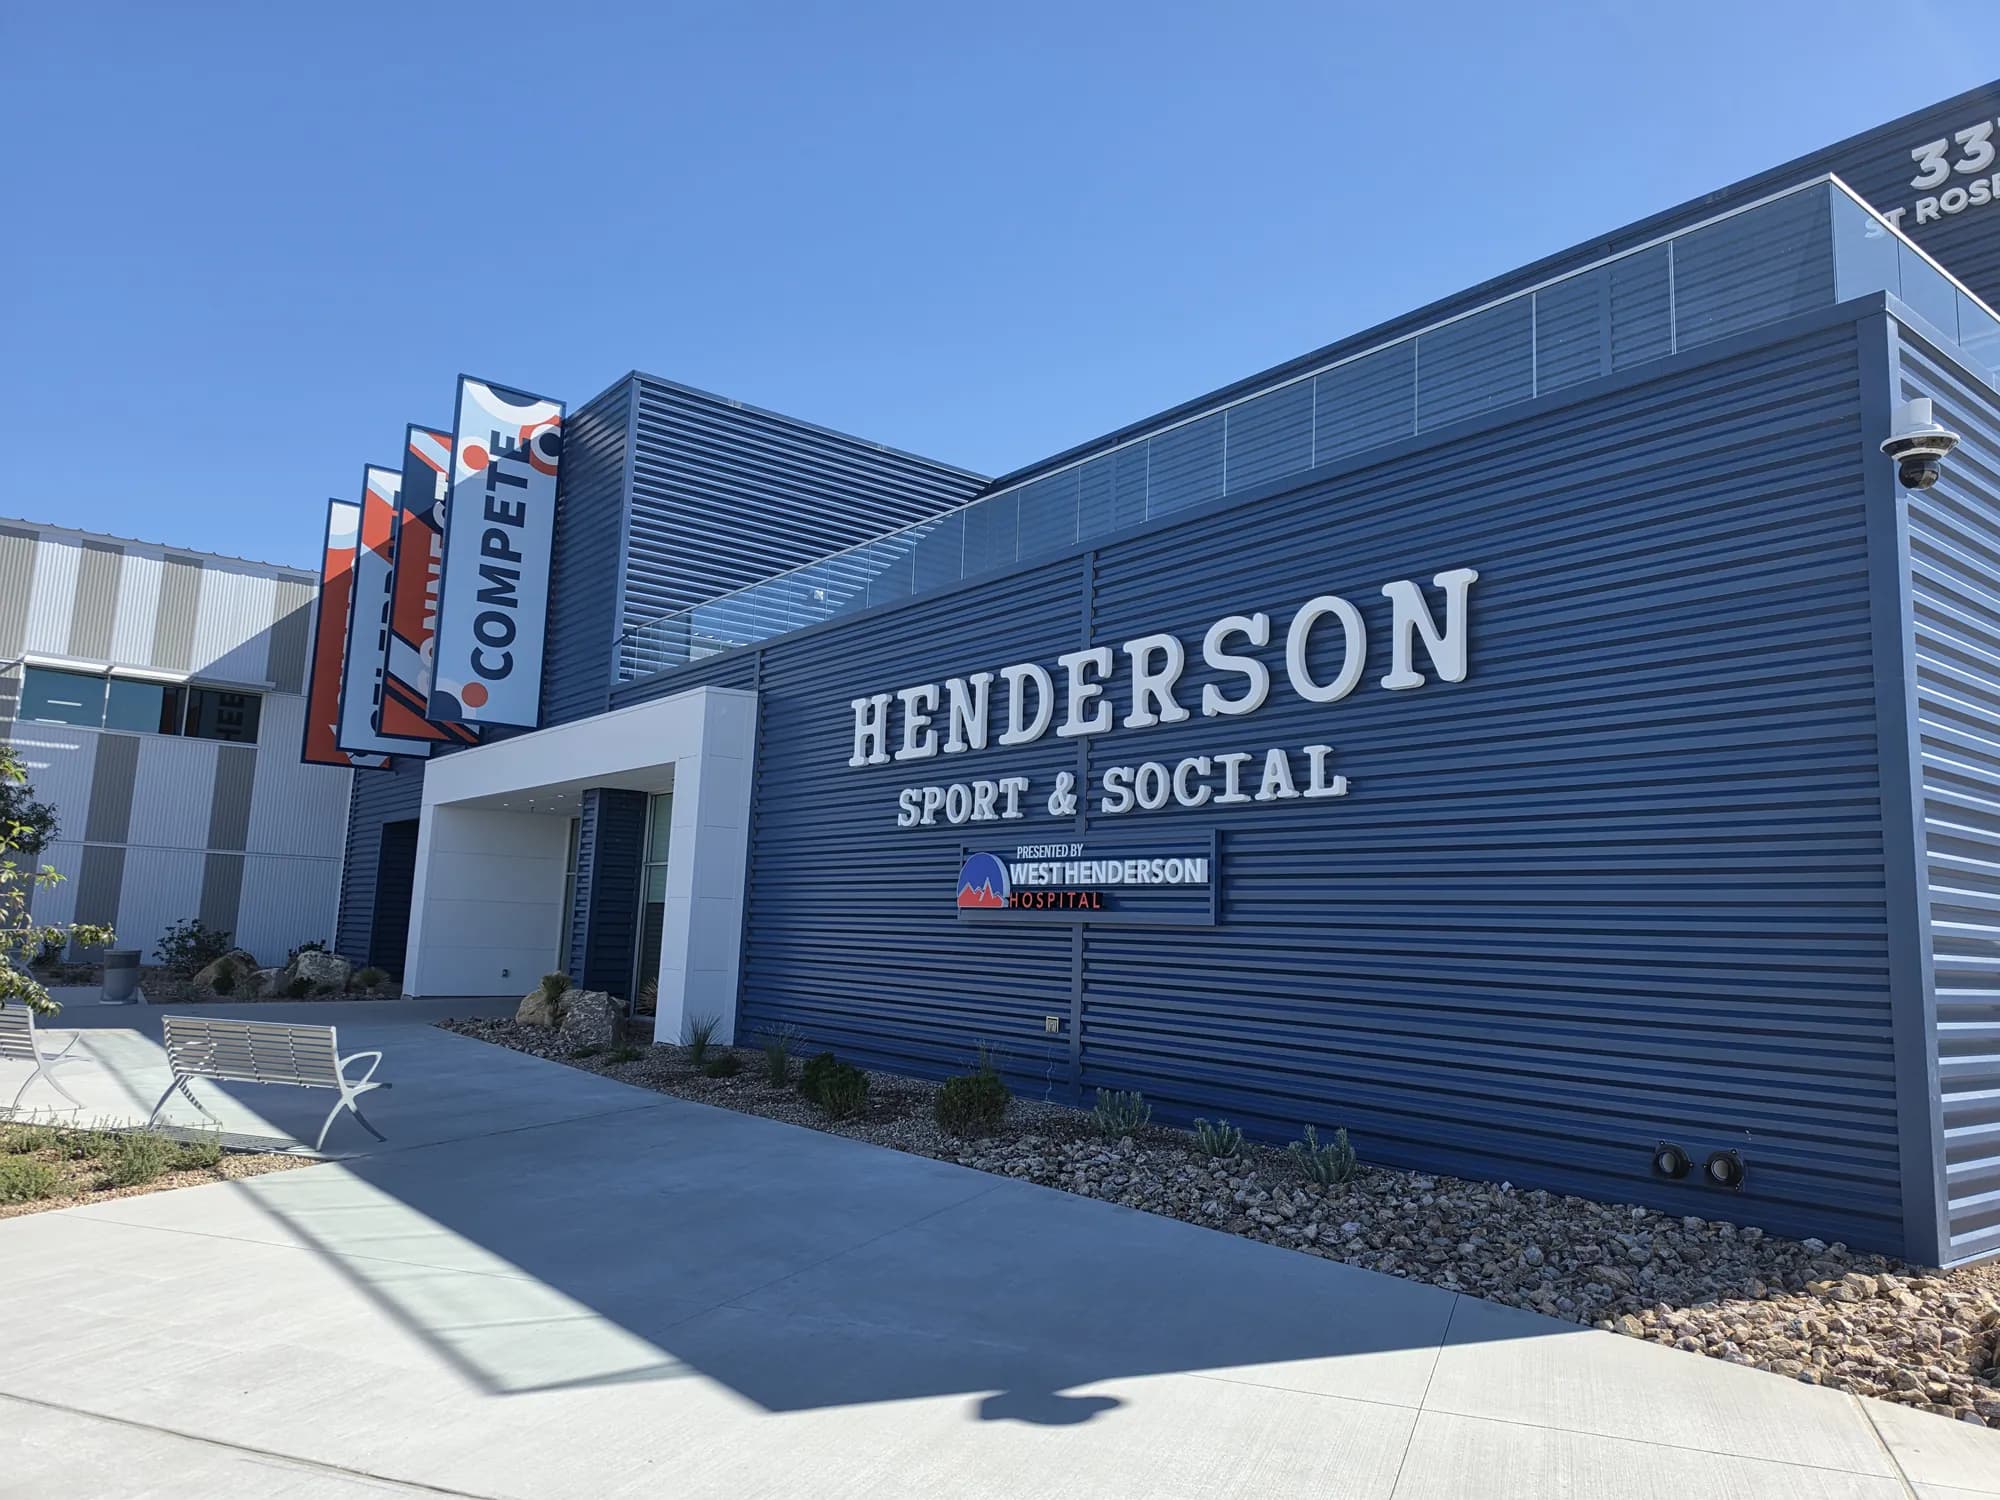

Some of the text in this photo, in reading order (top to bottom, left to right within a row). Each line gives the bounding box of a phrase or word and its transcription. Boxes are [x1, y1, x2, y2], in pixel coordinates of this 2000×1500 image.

[1910, 117, 2000, 190] 33
[470, 430, 531, 680] COMPETE
[848, 567, 1479, 768] HENDERSON
[897, 744, 1351, 828] SPORT & SOCIAL
[1010, 858, 1205, 886] WEST HENDERSON
[1016, 843, 1083, 859] PRESENTED BY
[1009, 892, 1101, 909] HOSPITAL
